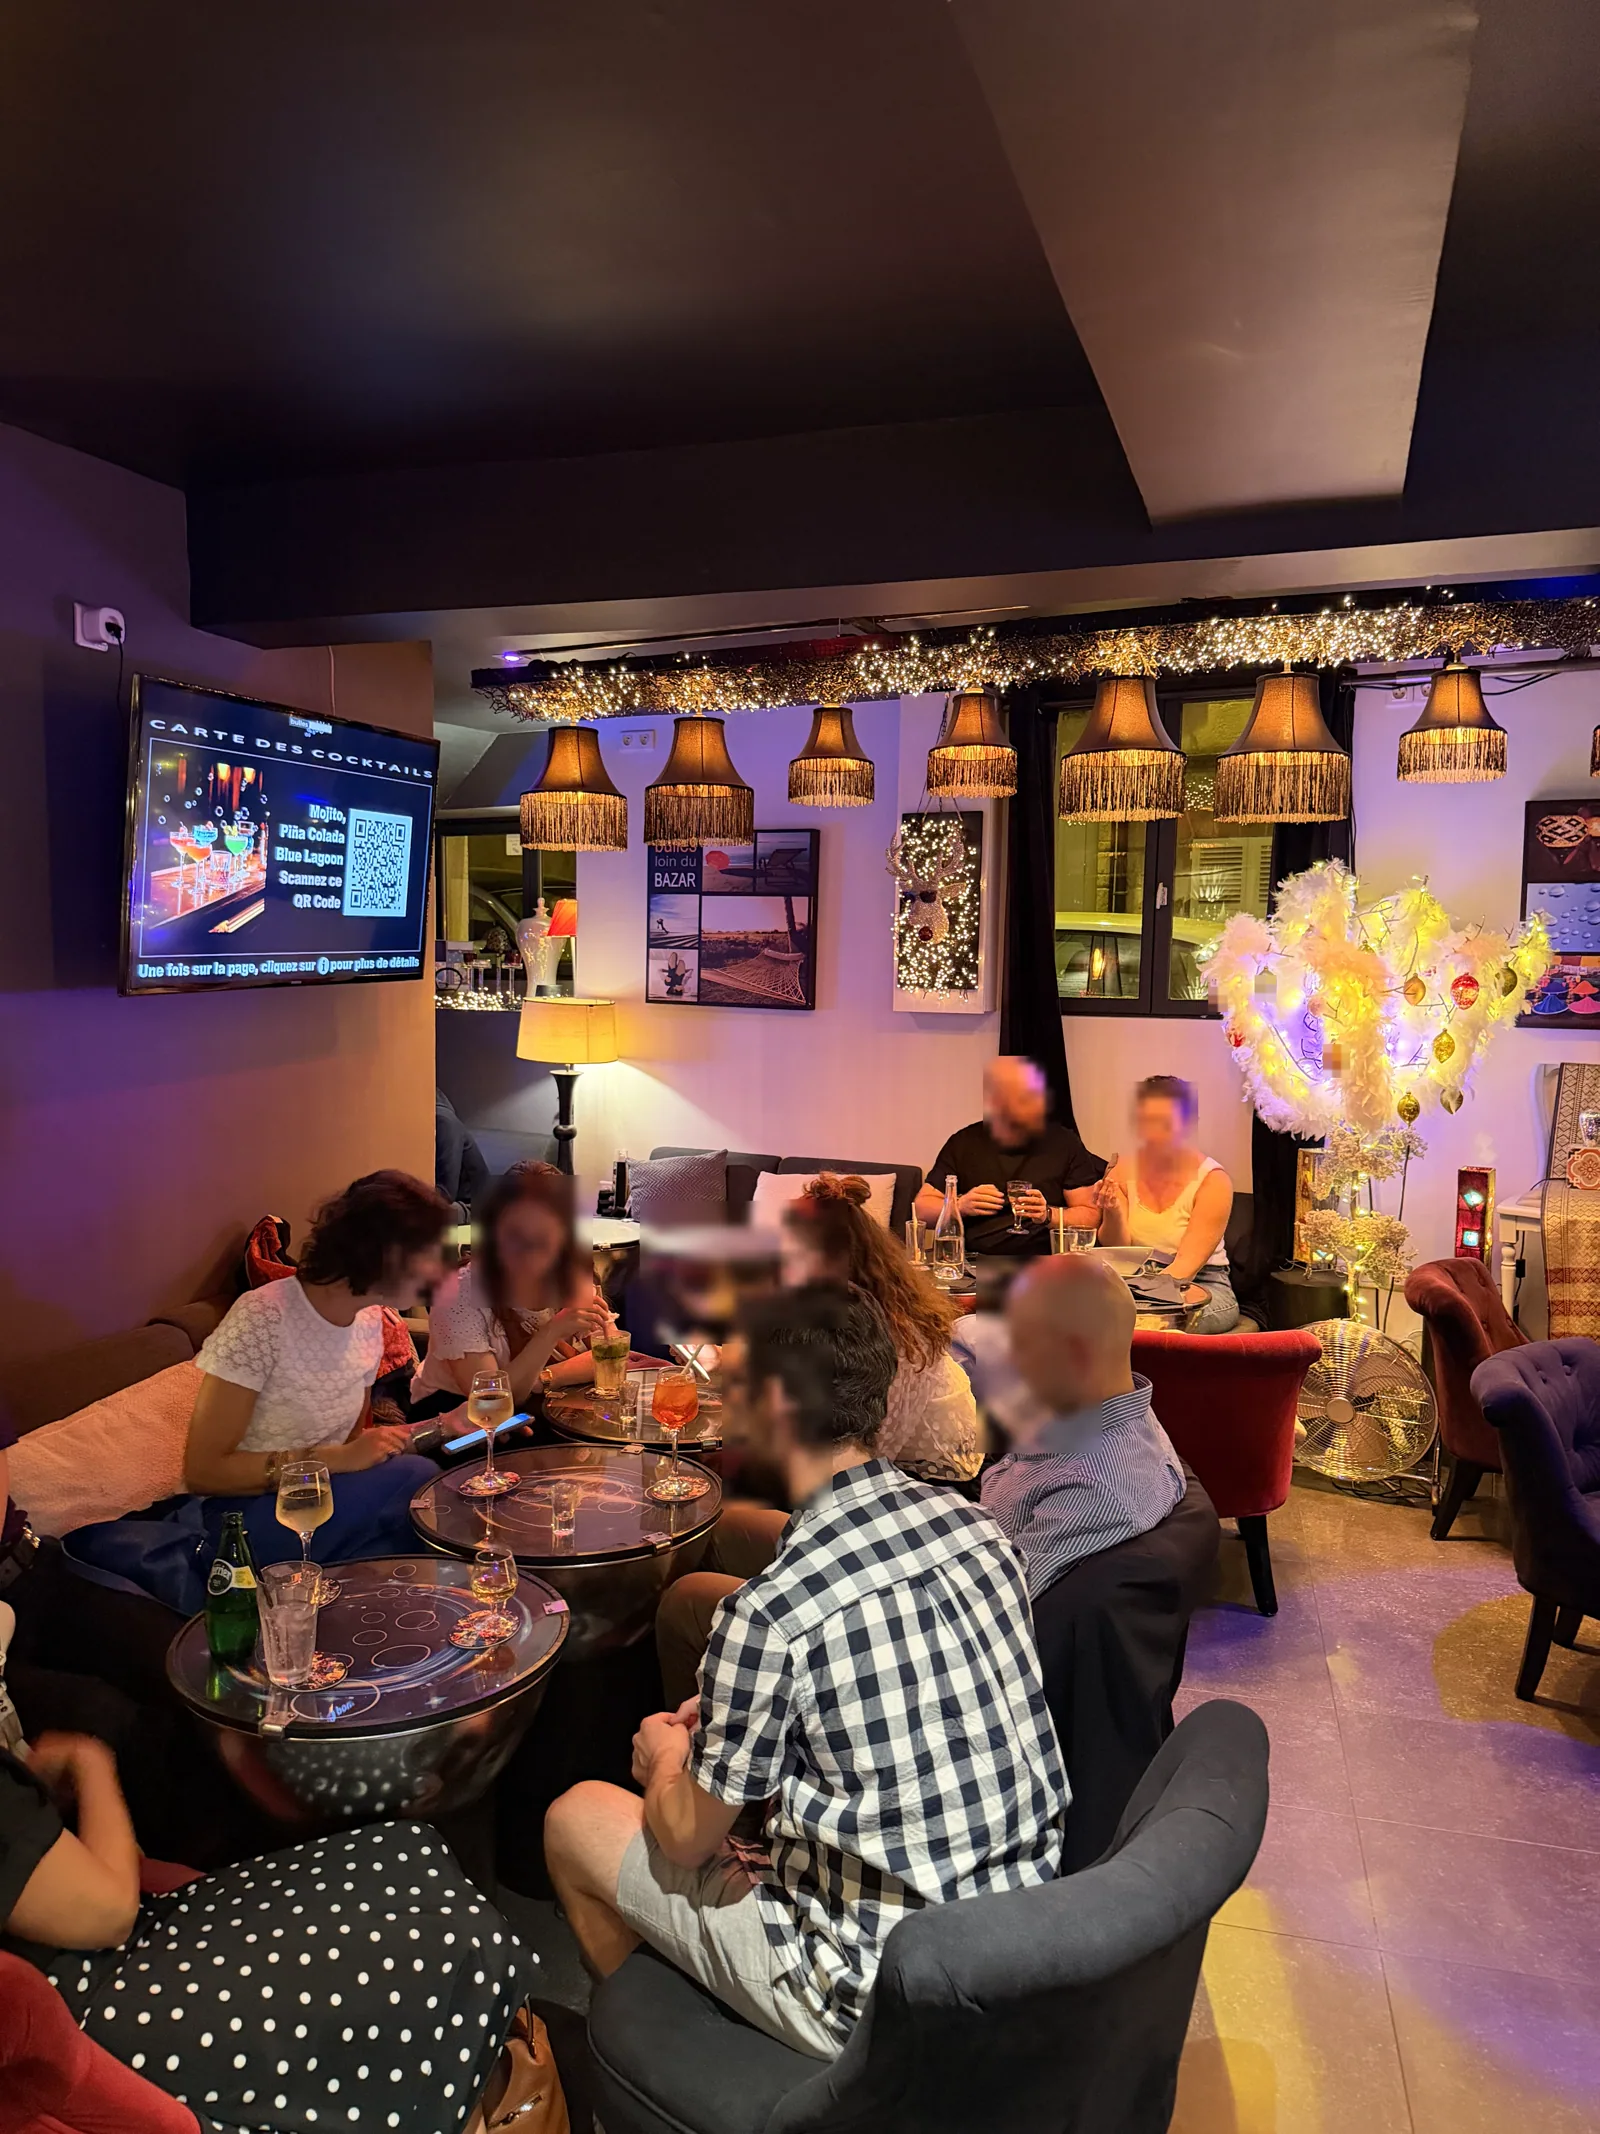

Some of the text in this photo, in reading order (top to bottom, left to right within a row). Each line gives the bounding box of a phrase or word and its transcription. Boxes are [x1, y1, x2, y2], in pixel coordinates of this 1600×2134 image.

[149, 719, 433, 779] CARTE DES COCKTAILS
[308, 804, 347, 825] Mojito,
[279, 823, 345, 844] Piña Colada
[275, 846, 344, 867] Blue Lagoon
[655, 855, 697, 867] loin du
[278, 870, 343, 887] Scannez ce
[654, 872, 696, 888] BAZAR
[292, 893, 342, 909] QR Code
[137, 963, 164, 978] Une
[165, 962, 190, 977] fois
[191, 964, 212, 976] sur
[212, 961, 226, 975] la
[226, 963, 259, 977] page,
[260, 959, 298, 976] cliquez
[298, 960, 316, 972] sur
[329, 960, 353, 973] pour
[354, 957, 375, 972] plus
[376, 957, 389, 969] de
[389, 956, 419, 968] détails
